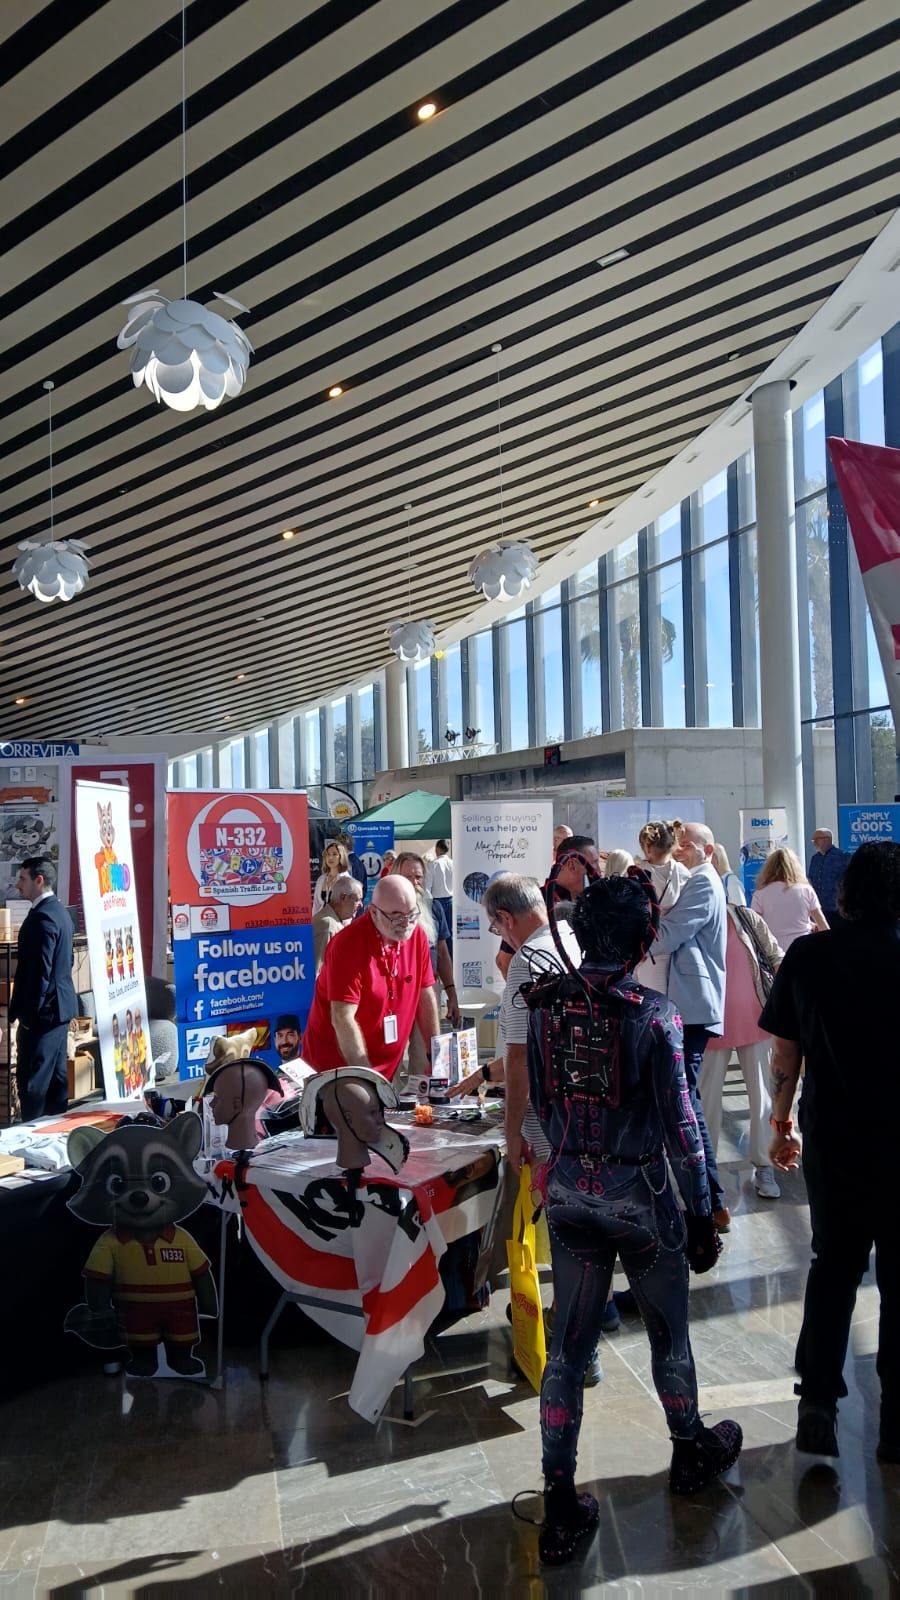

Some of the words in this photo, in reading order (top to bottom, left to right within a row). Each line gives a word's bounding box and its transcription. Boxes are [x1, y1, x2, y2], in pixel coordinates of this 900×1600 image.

[462, 814, 491, 823] Selling
[505, 813, 542, 823] buying?
[861, 811, 890, 820] SIMPLY
[497, 824, 518, 833] help
[520, 825, 538, 833] you
[851, 817, 893, 832] doors
[215, 827, 266, 847] N-332
[850, 834, 858, 842] &
[486, 848, 526, 863] Properties
[212, 885, 239, 895] Spanish
[240, 885, 261, 893] Traffic
[198, 939, 260, 959] Follow
[264, 942, 281, 954] us
[285, 941, 302, 953] on
[193, 956, 306, 992] facebook
[210, 992, 264, 1008] facebook.com/
[162, 1250, 184, 1261] N332
